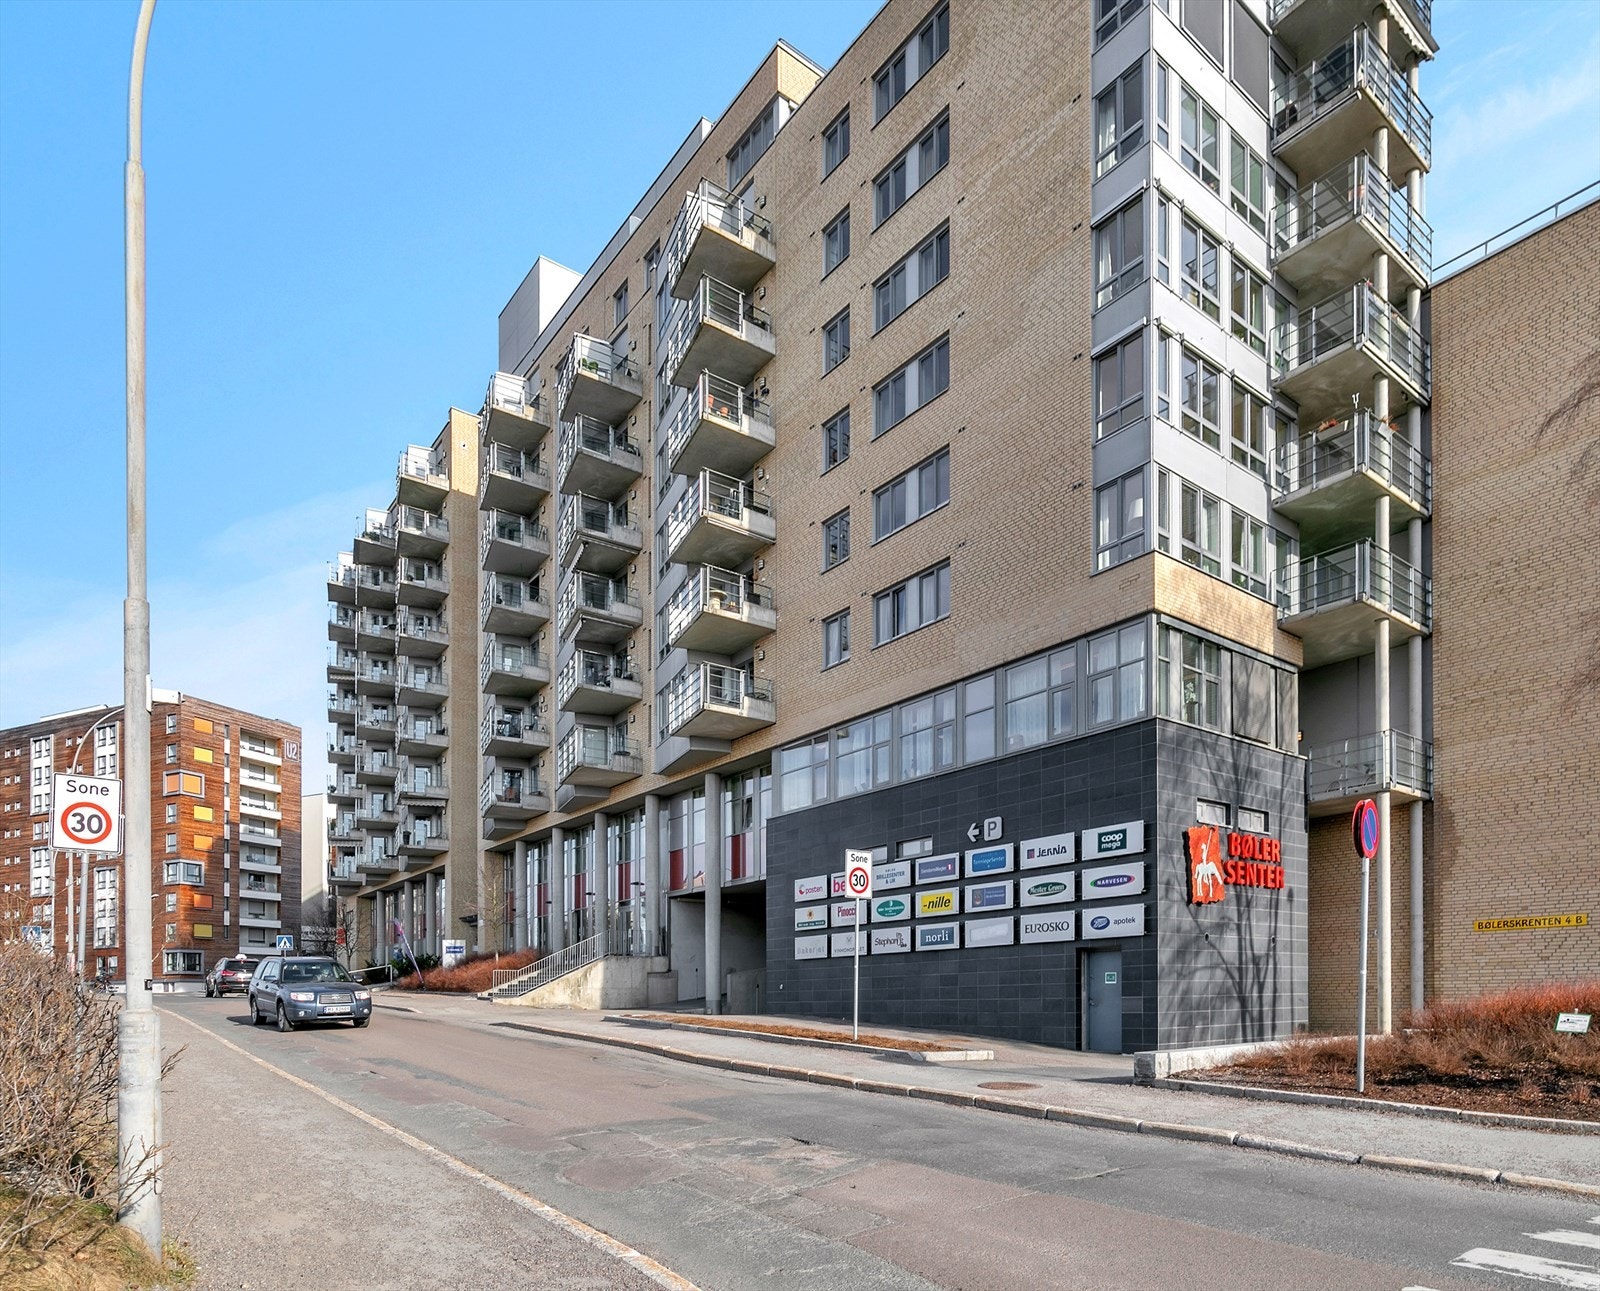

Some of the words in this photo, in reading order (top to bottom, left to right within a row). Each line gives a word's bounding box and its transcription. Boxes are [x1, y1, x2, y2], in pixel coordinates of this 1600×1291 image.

[286, 741, 298, 759] U2
[66, 779, 110, 797] Sone
[71, 812, 103, 834] 30
[987, 820, 998, 838] P
[1101, 832, 1124, 843] coop
[1101, 841, 1121, 850] mega
[1228, 832, 1281, 863] BØLER
[850, 853, 869, 864] Sone
[852, 873, 866, 888] 30
[1096, 876, 1128, 886] NARVESEN
[1224, 861, 1285, 889] SENTER
[805, 885, 823, 895] posten
[923, 895, 951, 909] -nille
[1024, 921, 1070, 934] EUROSKO
[1113, 916, 1136, 925] apotek
[1477, 916, 1561, 930] BØLERSKRENTEN
[1565, 916, 1571, 924] 4
[1575, 915, 1583, 924] B
[925, 929, 949, 942] norli
